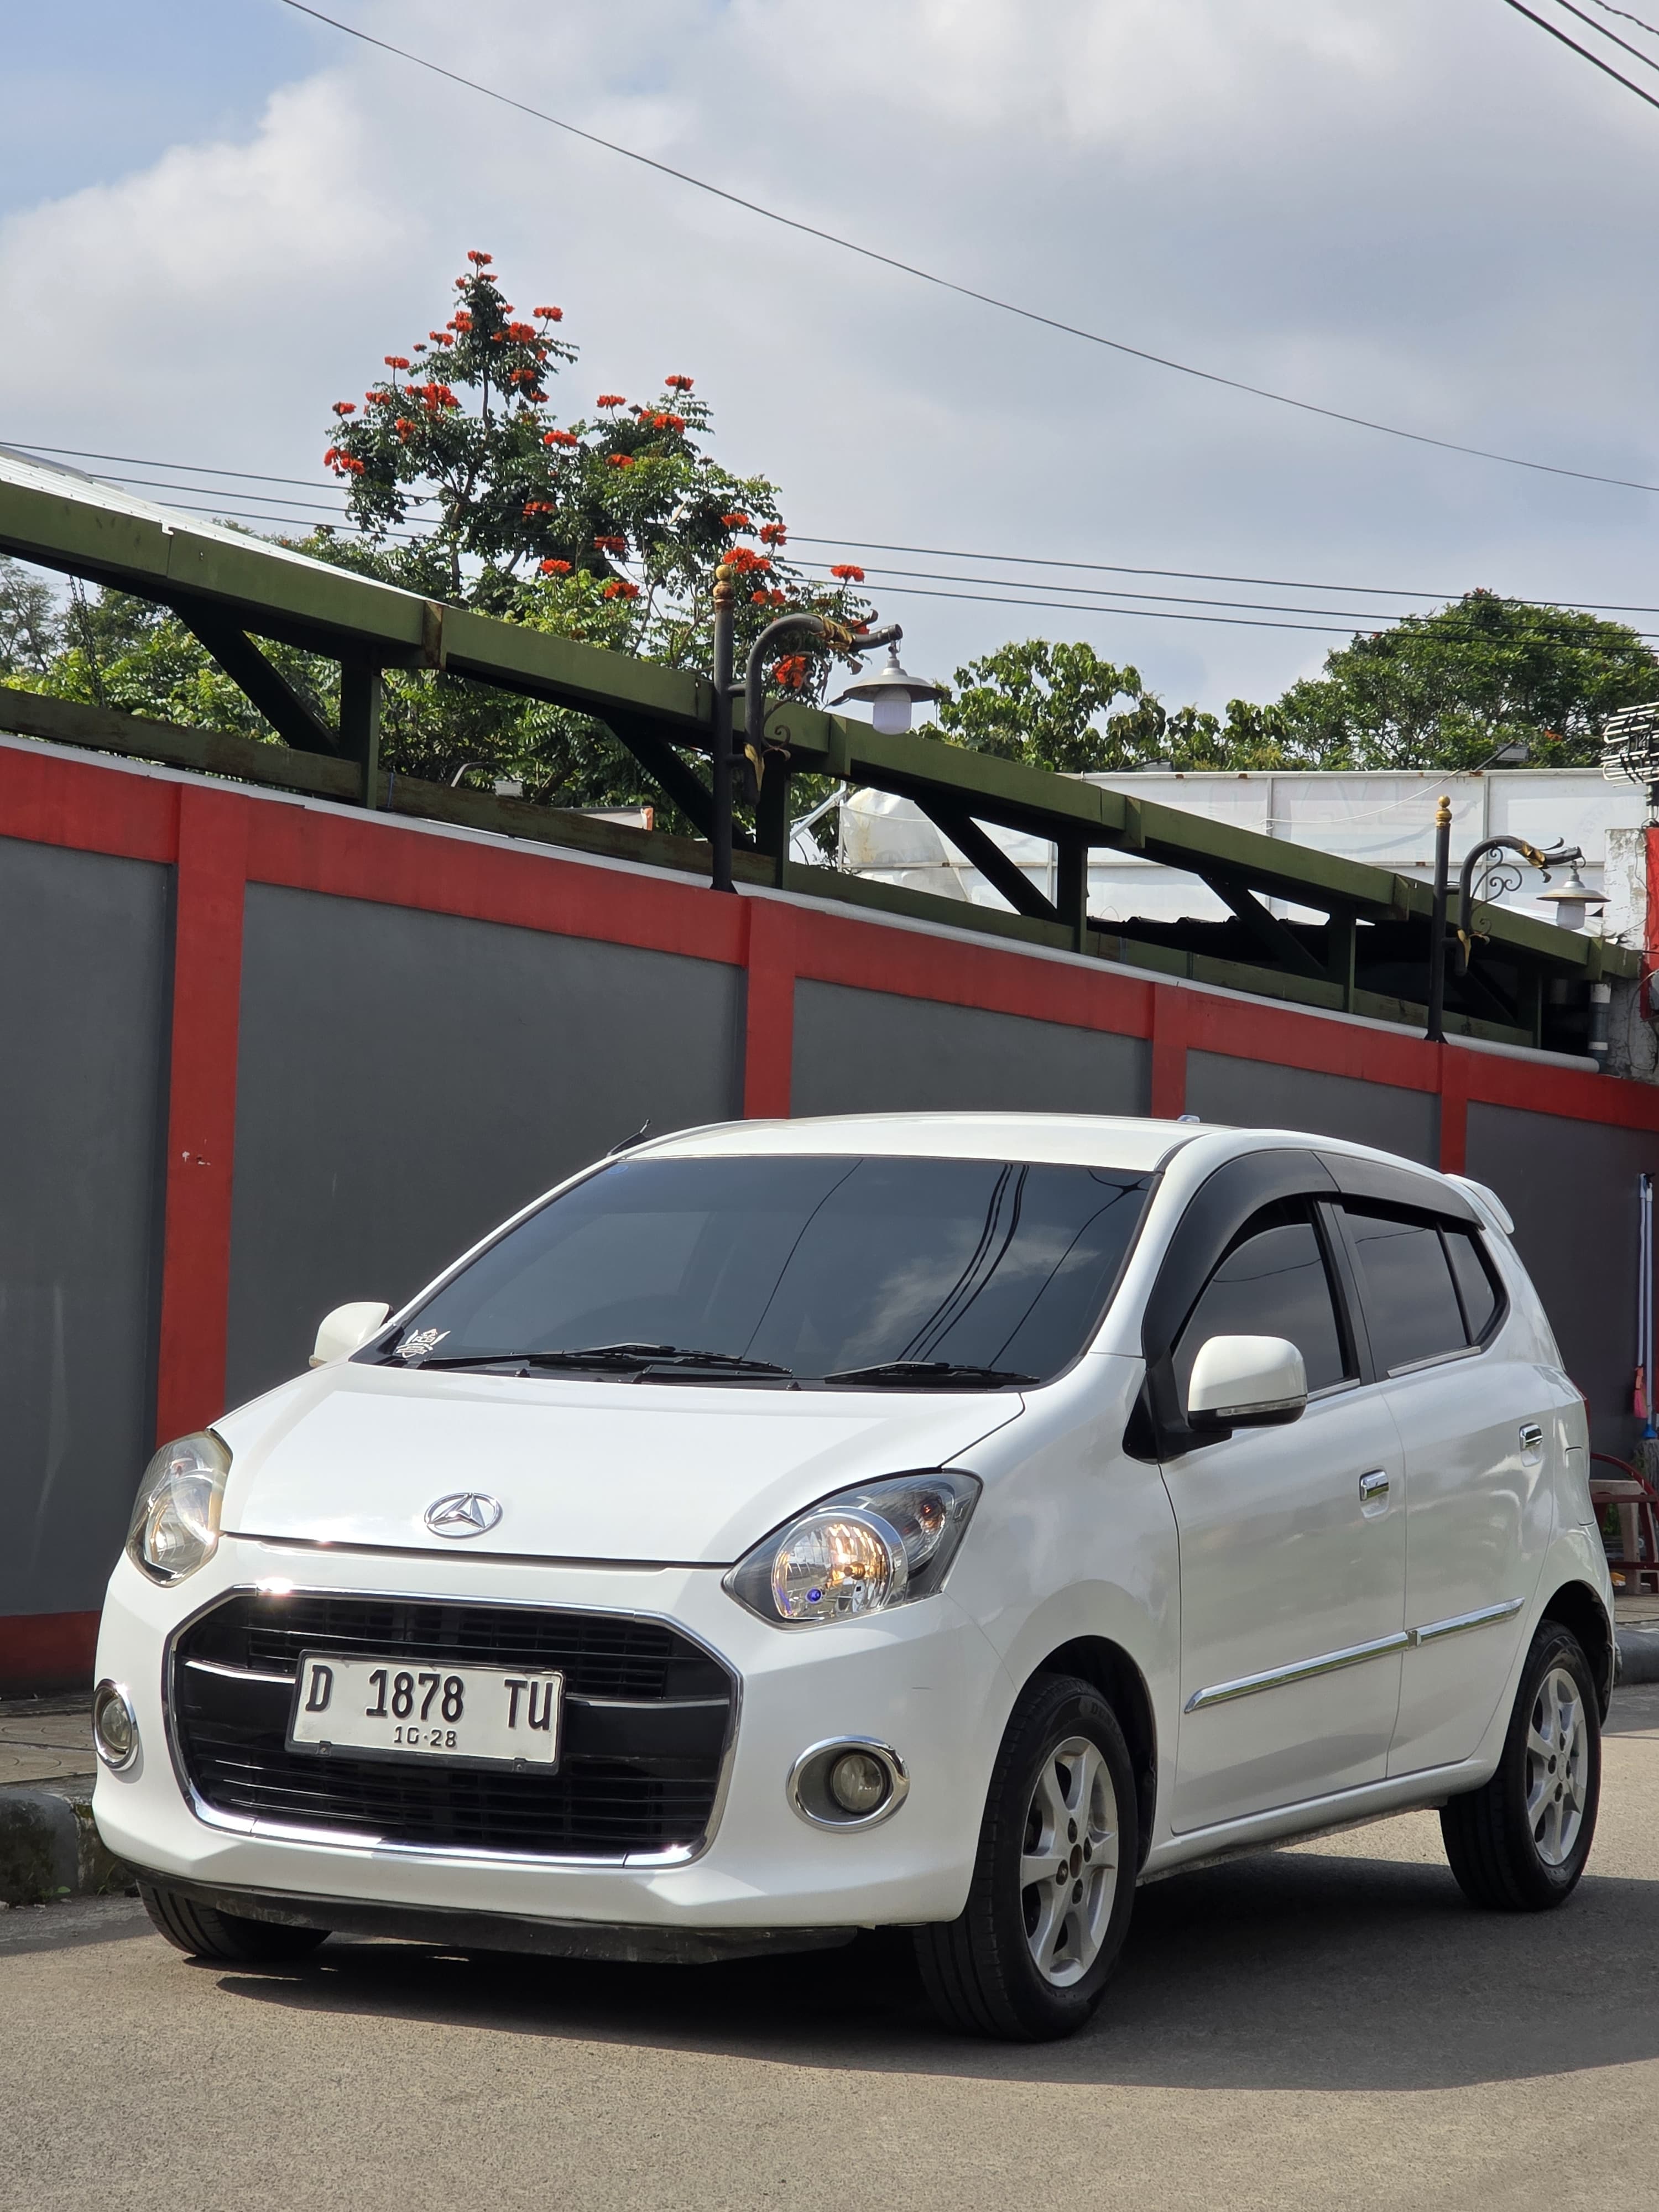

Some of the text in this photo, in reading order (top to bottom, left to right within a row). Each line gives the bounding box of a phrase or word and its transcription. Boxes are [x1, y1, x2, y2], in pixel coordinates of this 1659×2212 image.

[306, 1665, 553, 1730] D 1878 TU
